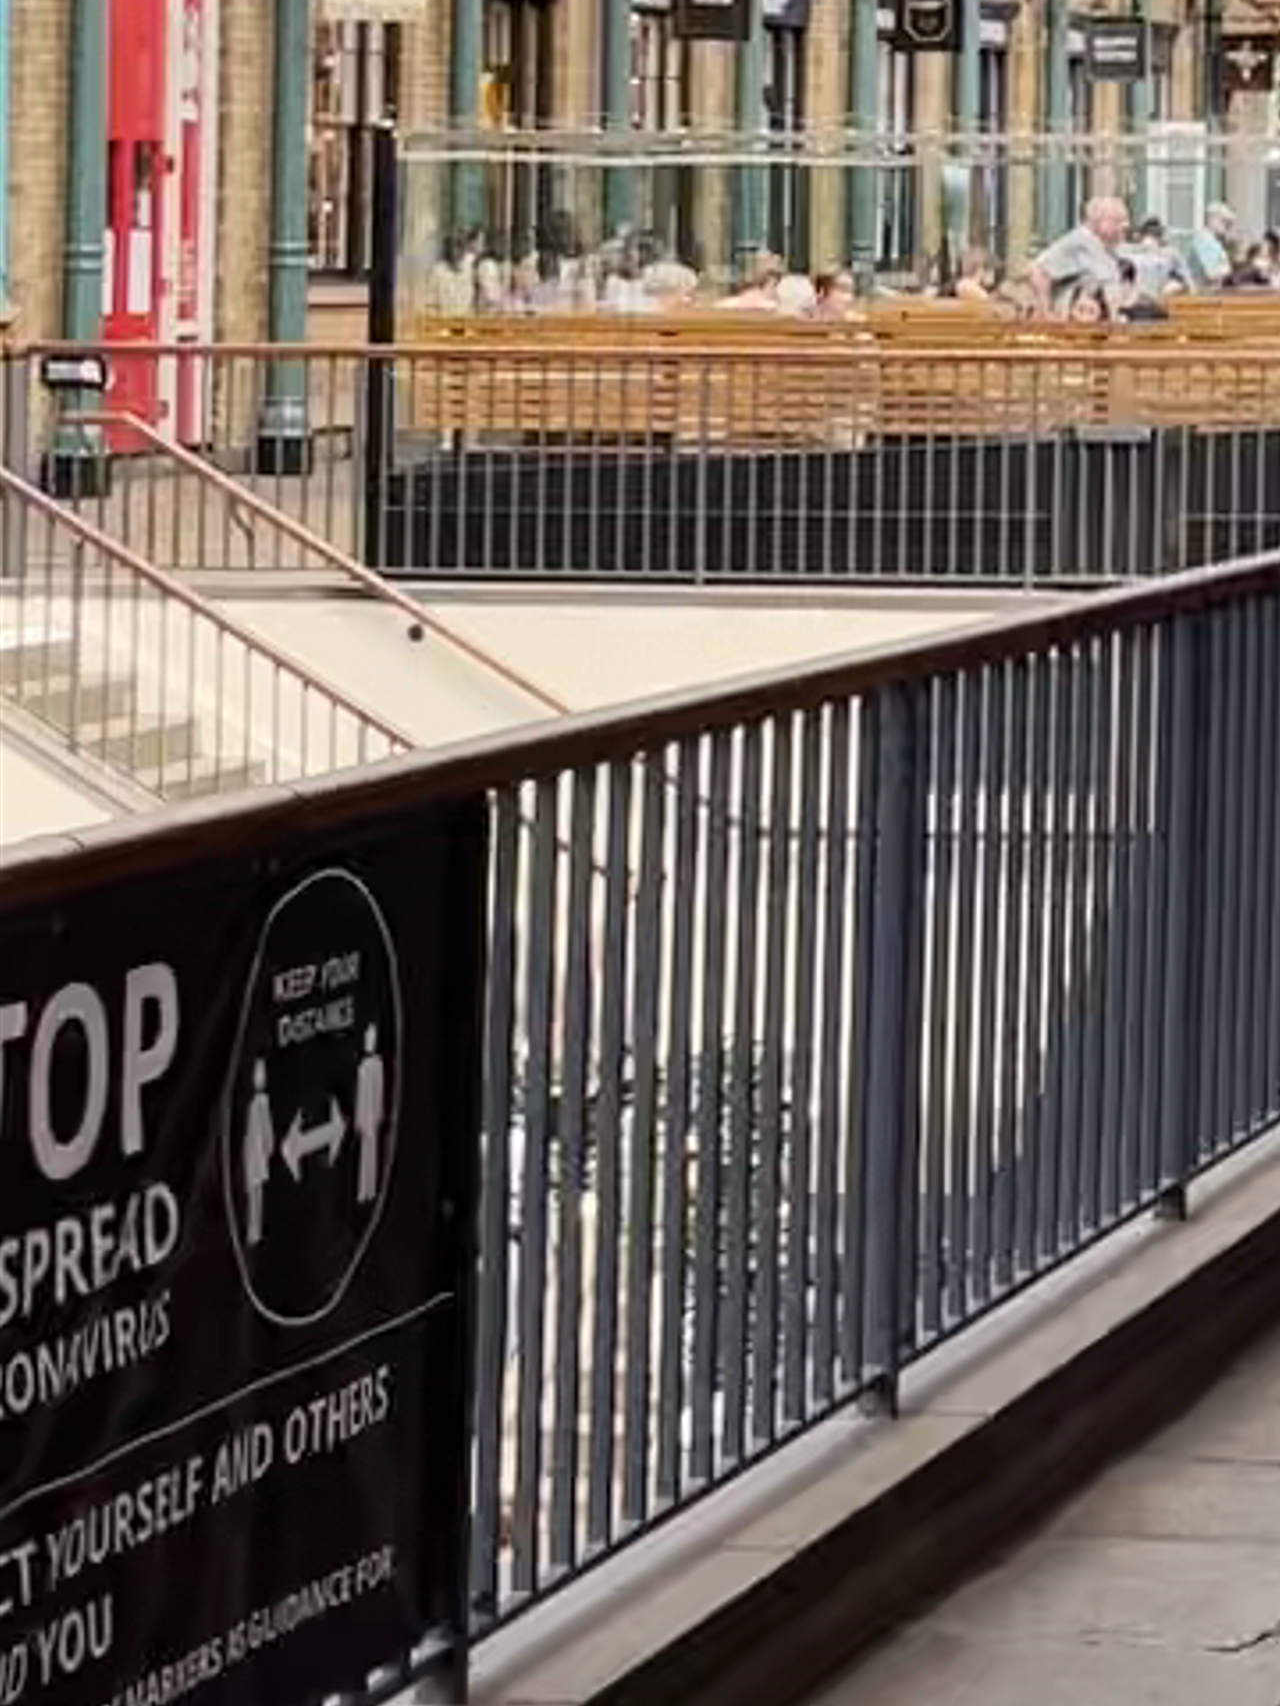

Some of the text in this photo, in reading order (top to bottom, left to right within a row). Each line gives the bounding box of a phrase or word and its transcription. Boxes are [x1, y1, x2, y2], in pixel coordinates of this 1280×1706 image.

[0, 1181, 179, 1328] SPREAD
[45, 1455, 204, 1591] YOURSELF
[211, 1423, 274, 1504] AND
[284, 1364, 391, 1465] OTHERS
[37, 1592, 114, 1686] YOU
